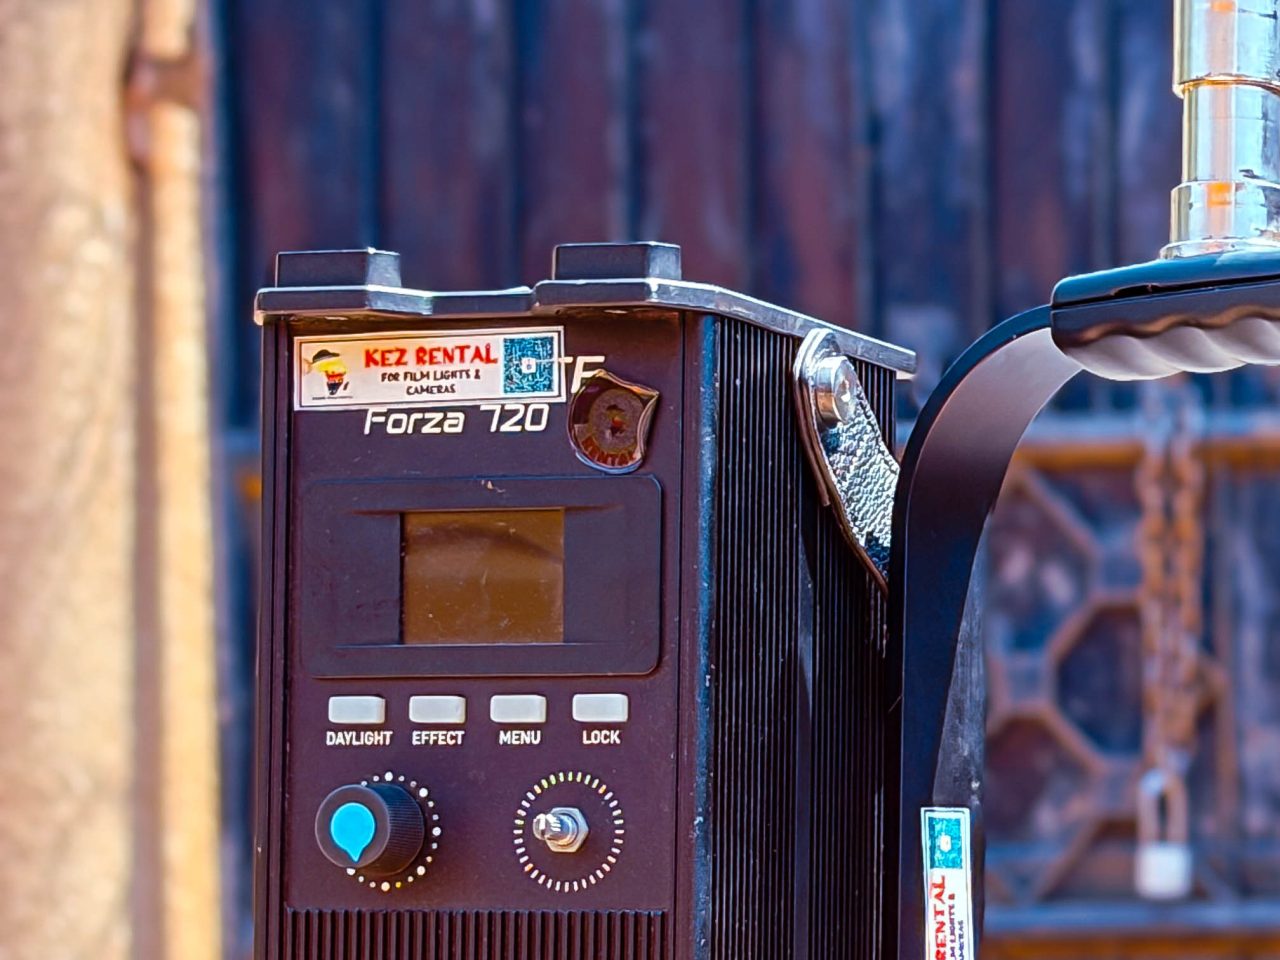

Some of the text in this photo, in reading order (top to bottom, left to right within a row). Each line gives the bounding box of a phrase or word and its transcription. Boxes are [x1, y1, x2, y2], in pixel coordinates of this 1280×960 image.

[364, 343, 498, 368] KEZ RENTAL
[381, 372, 401, 383] FOR
[403, 370, 430, 382] FILM
[433, 369, 471, 381] LIGHTS
[406, 384, 456, 396] CAMERAS
[364, 403, 550, 435] Forza 720
[326, 730, 393, 746] DAYLIGHT
[412, 730, 465, 745] EFFECT
[499, 730, 541, 745] MENU
[582, 730, 621, 745] LOCK
